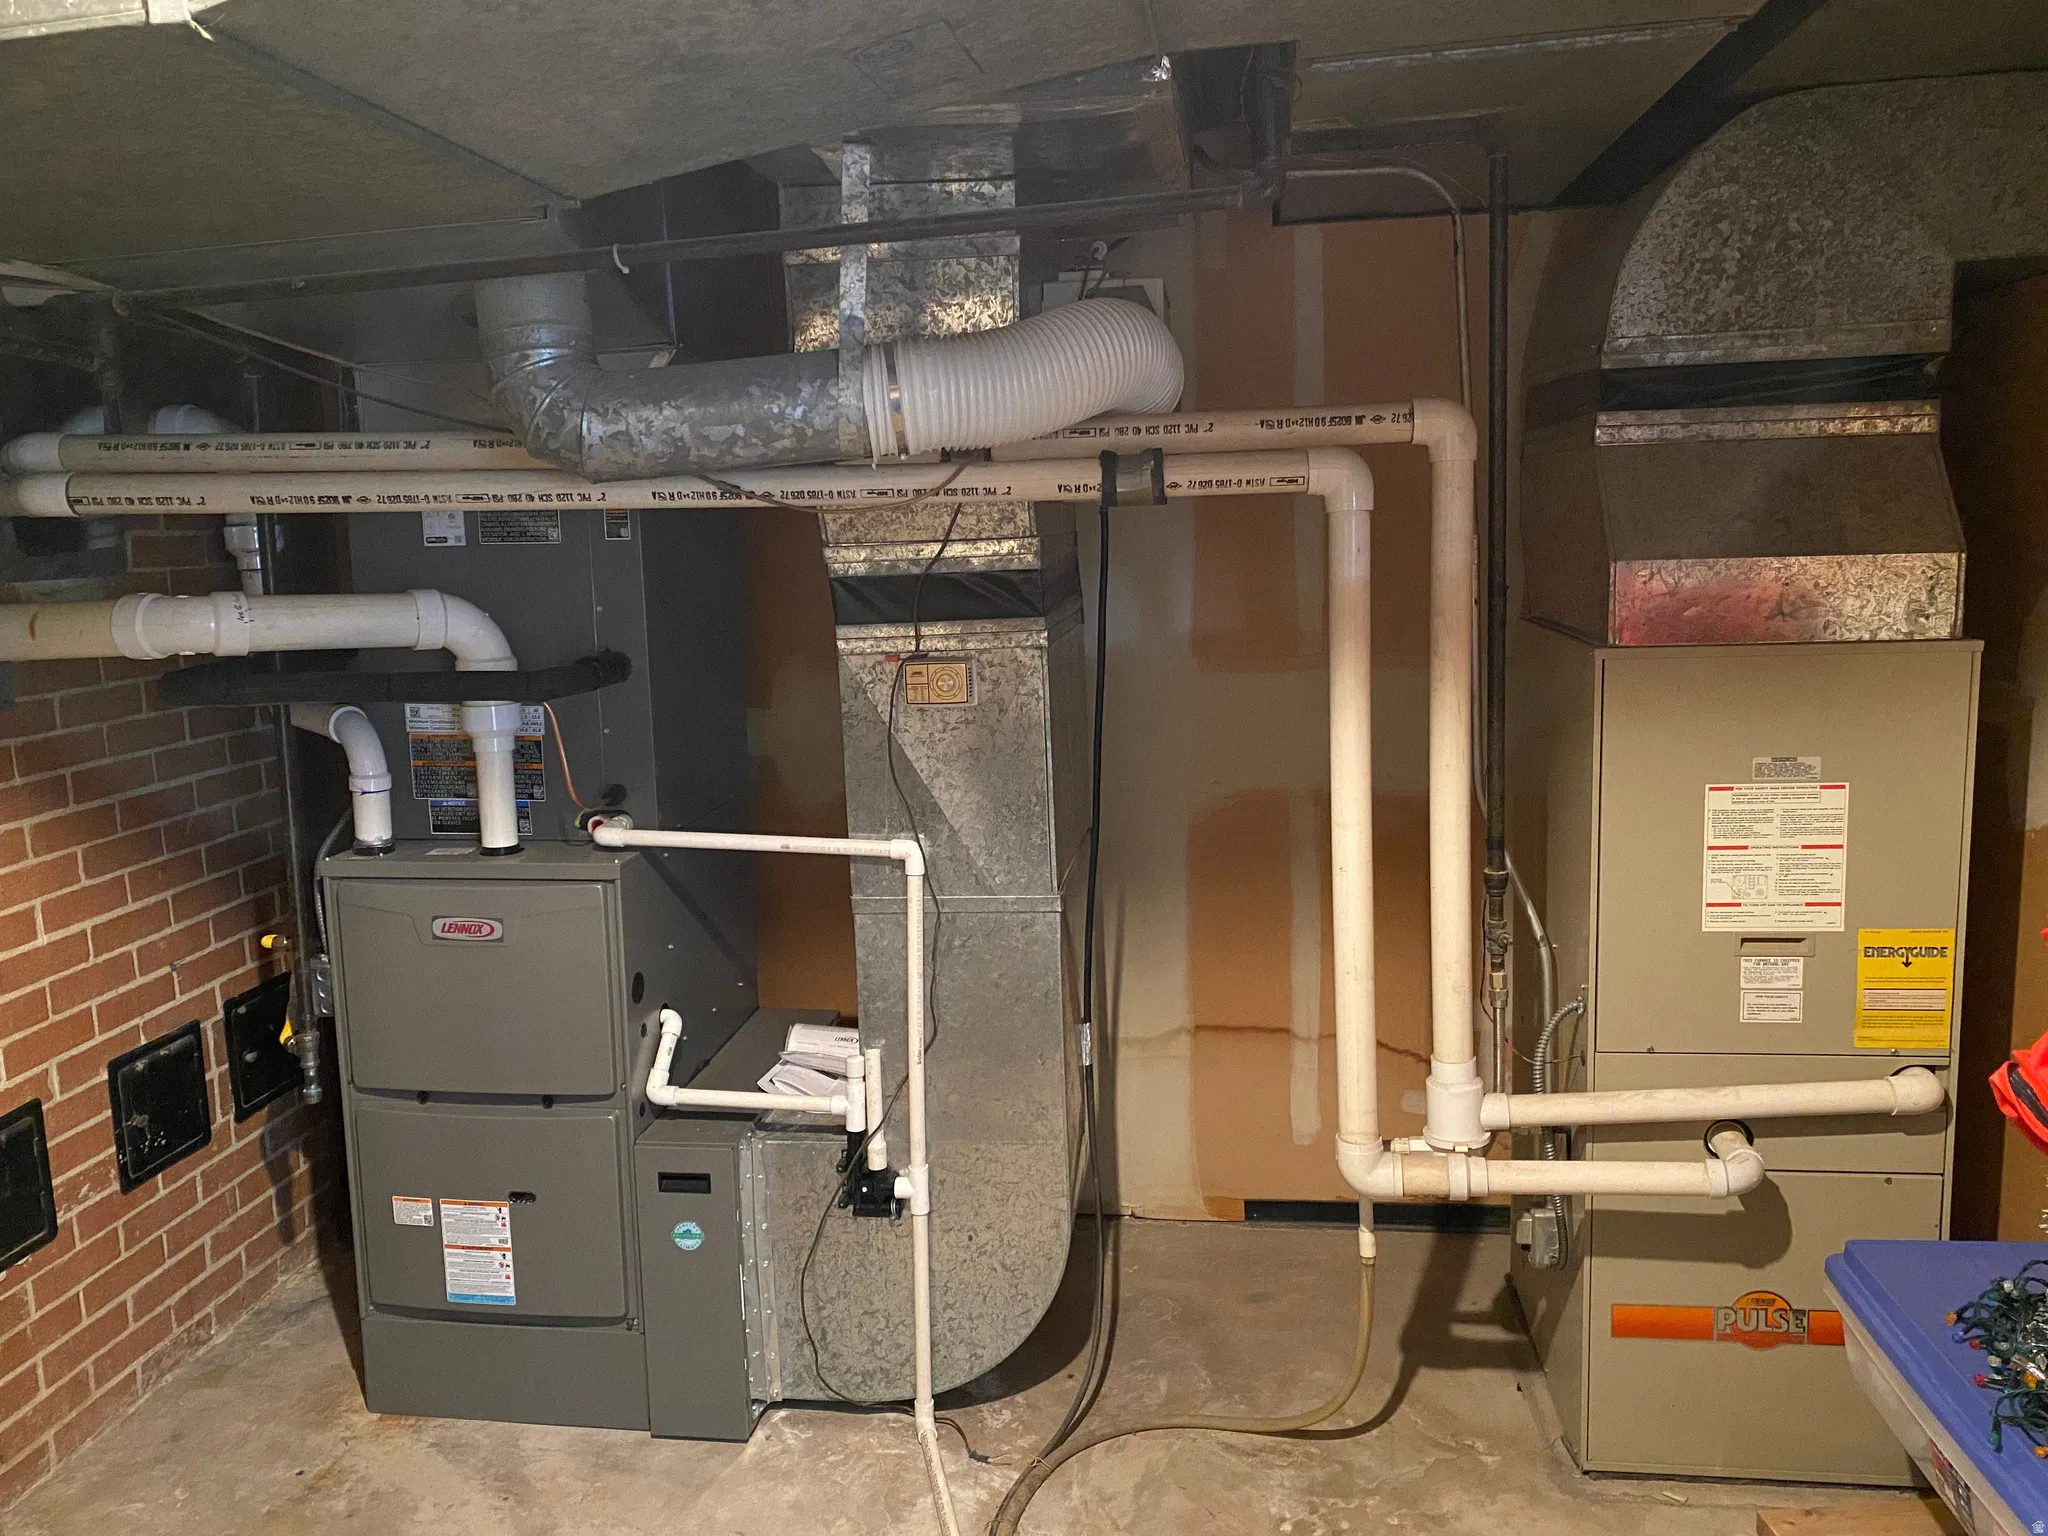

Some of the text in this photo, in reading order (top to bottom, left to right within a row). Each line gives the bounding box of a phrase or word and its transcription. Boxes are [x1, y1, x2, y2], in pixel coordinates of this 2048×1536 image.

[1133, 427, 1141, 435] 40
[1145, 425, 1159, 435] SCH
[1164, 424, 1180, 434] 1120
[1185, 424, 1198, 433] PVC
[366, 440, 381, 449] SCH
[383, 440, 401, 449] 1120
[403, 441, 416, 449] PVC
[1215, 479, 1242, 488] D-1785
[1246, 479, 1265, 487] ASTM
[807, 490, 833, 499] D-1785
[837, 490, 856, 499] ASTM
[897, 489, 908, 497] PSI
[943, 488, 958, 496] SCH
[961, 488, 978, 496] 1120
[983, 487, 996, 496] PVC
[138, 497, 153, 505] SCH
[155, 497, 173, 505] 1120
[176, 497, 191, 505] PVC
[432, 495, 452, 503] ASTM
[492, 494, 504, 503] PSI
[508, 494, 522, 502] 280
[525, 494, 535, 502] 40
[538, 494, 553, 502] SCH
[556, 493, 574, 502] 1120
[577, 493, 591, 501] PVC
[441, 922, 485, 935] LENNOX
[1863, 946, 1948, 958] ENERGYGUIDE
[1716, 1307, 1807, 1336] PULSE
